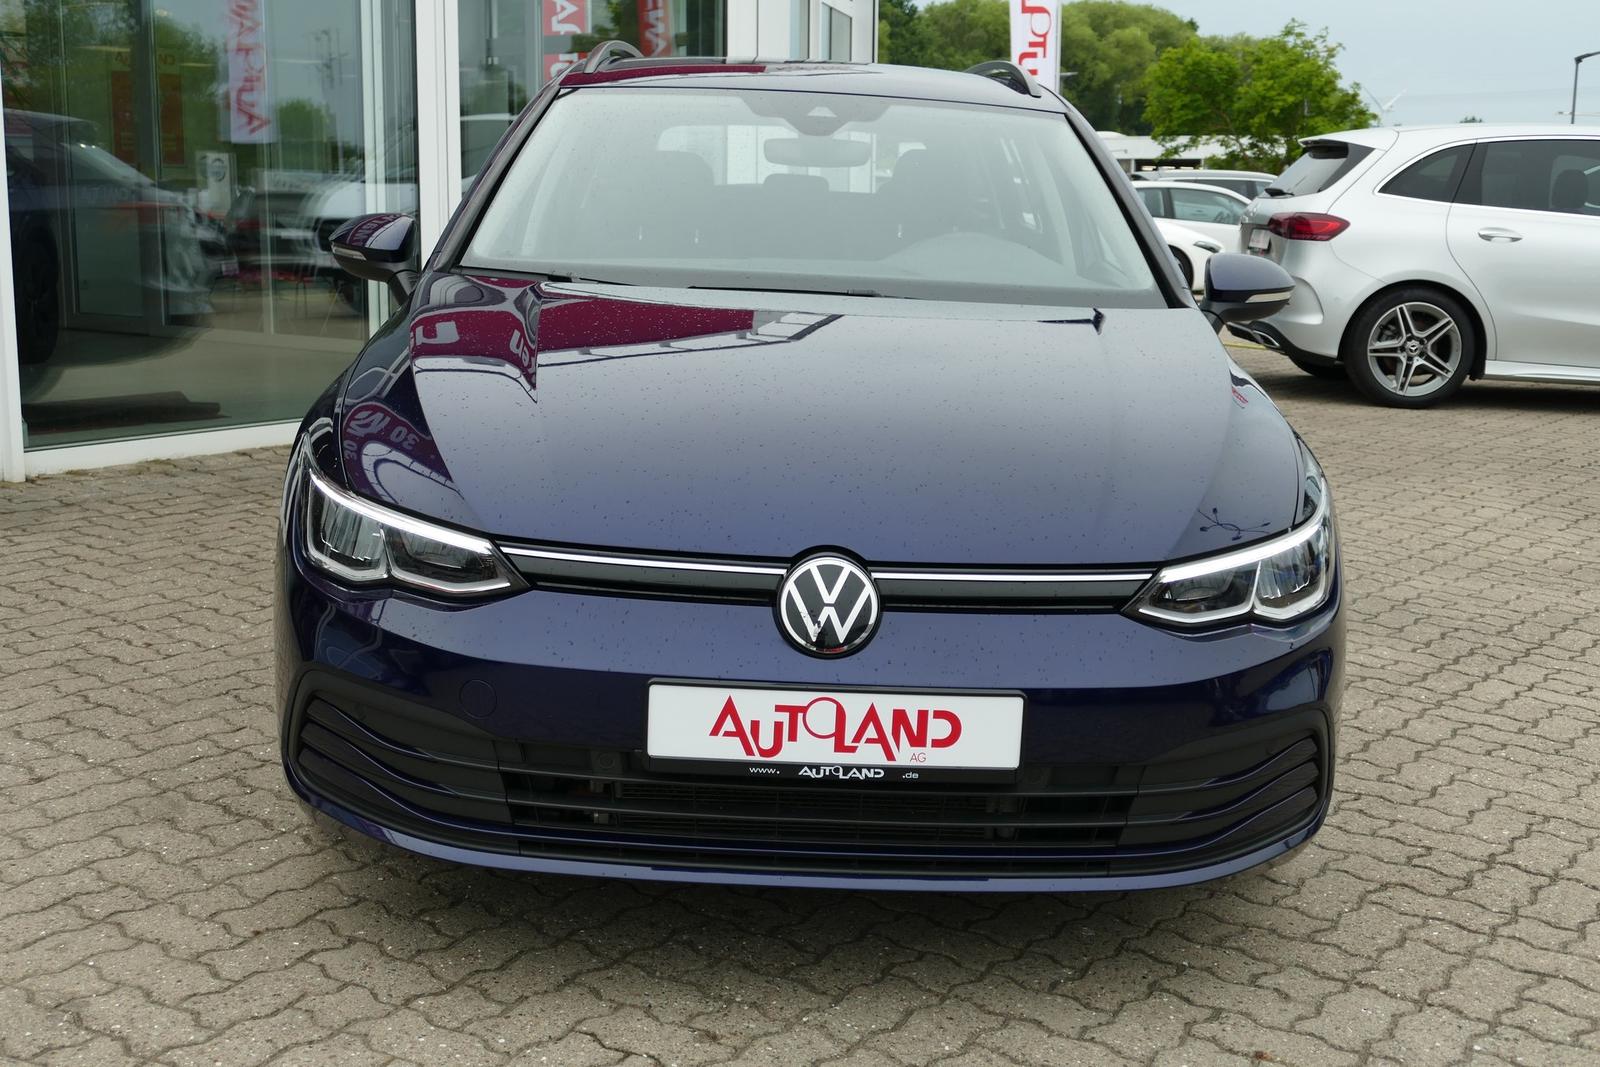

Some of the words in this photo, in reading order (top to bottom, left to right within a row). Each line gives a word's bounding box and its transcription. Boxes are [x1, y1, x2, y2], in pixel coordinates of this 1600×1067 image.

[785, 561, 873, 646] VW
[709, 695, 963, 762] AUTOLAND
[749, 766, 780, 776] www.
[798, 765, 885, 780] AUTOLAND
[902, 771, 919, 780] .de
[909, 752, 927, 763] AG
